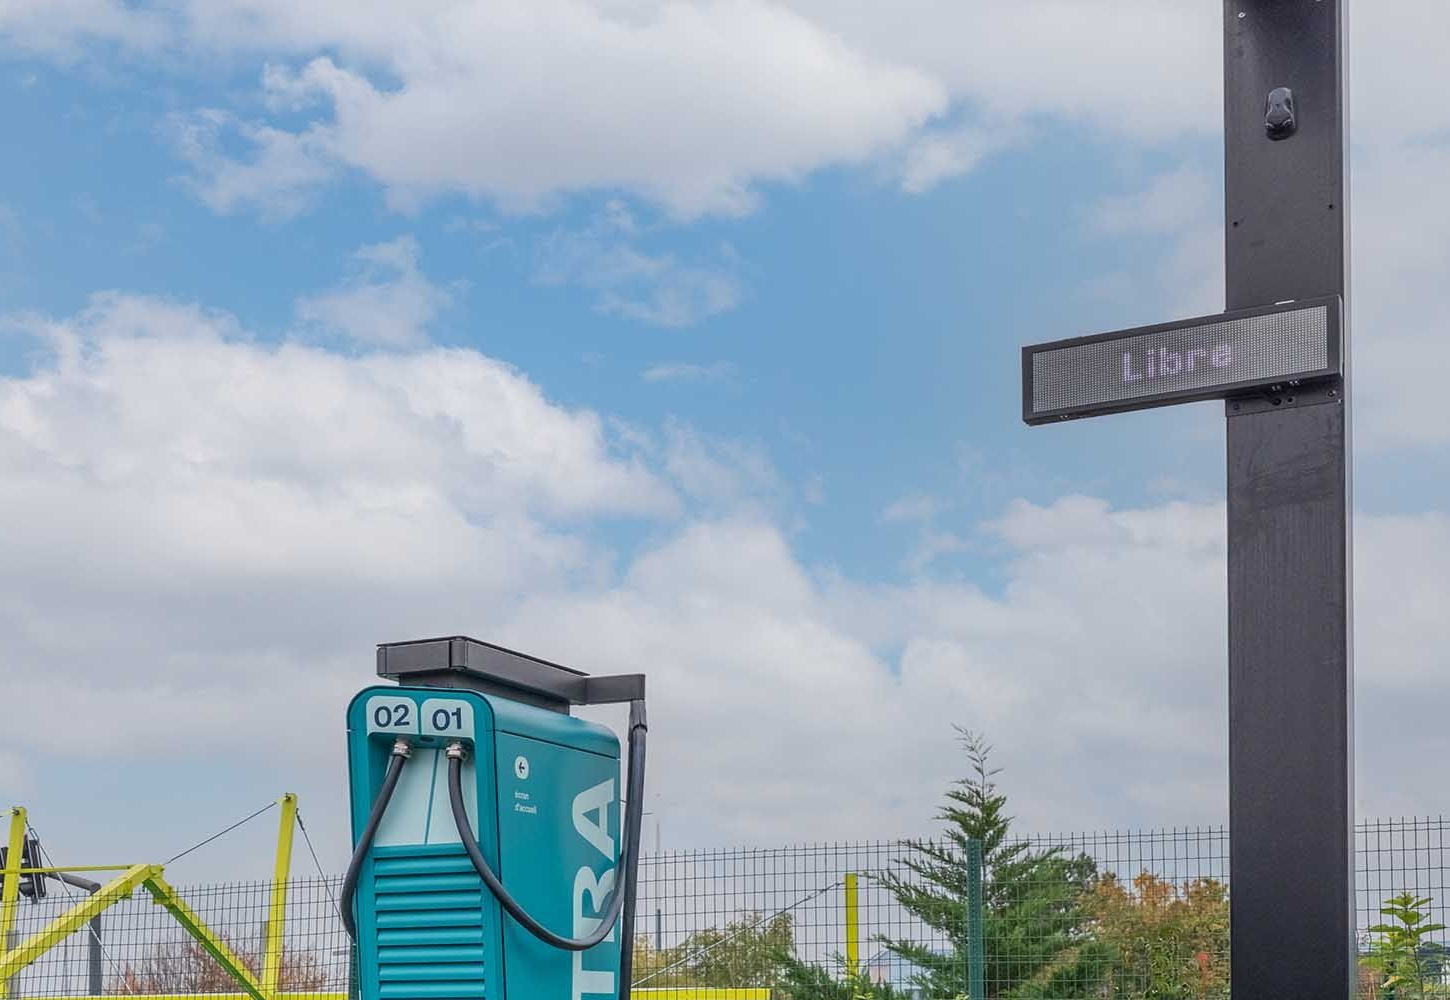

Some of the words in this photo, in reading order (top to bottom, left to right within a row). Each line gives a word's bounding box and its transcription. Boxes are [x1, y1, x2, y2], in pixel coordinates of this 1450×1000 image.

[1122, 342, 1232, 382] Libre
[374, 704, 410, 728] 02
[432, 707, 462, 731] 01
